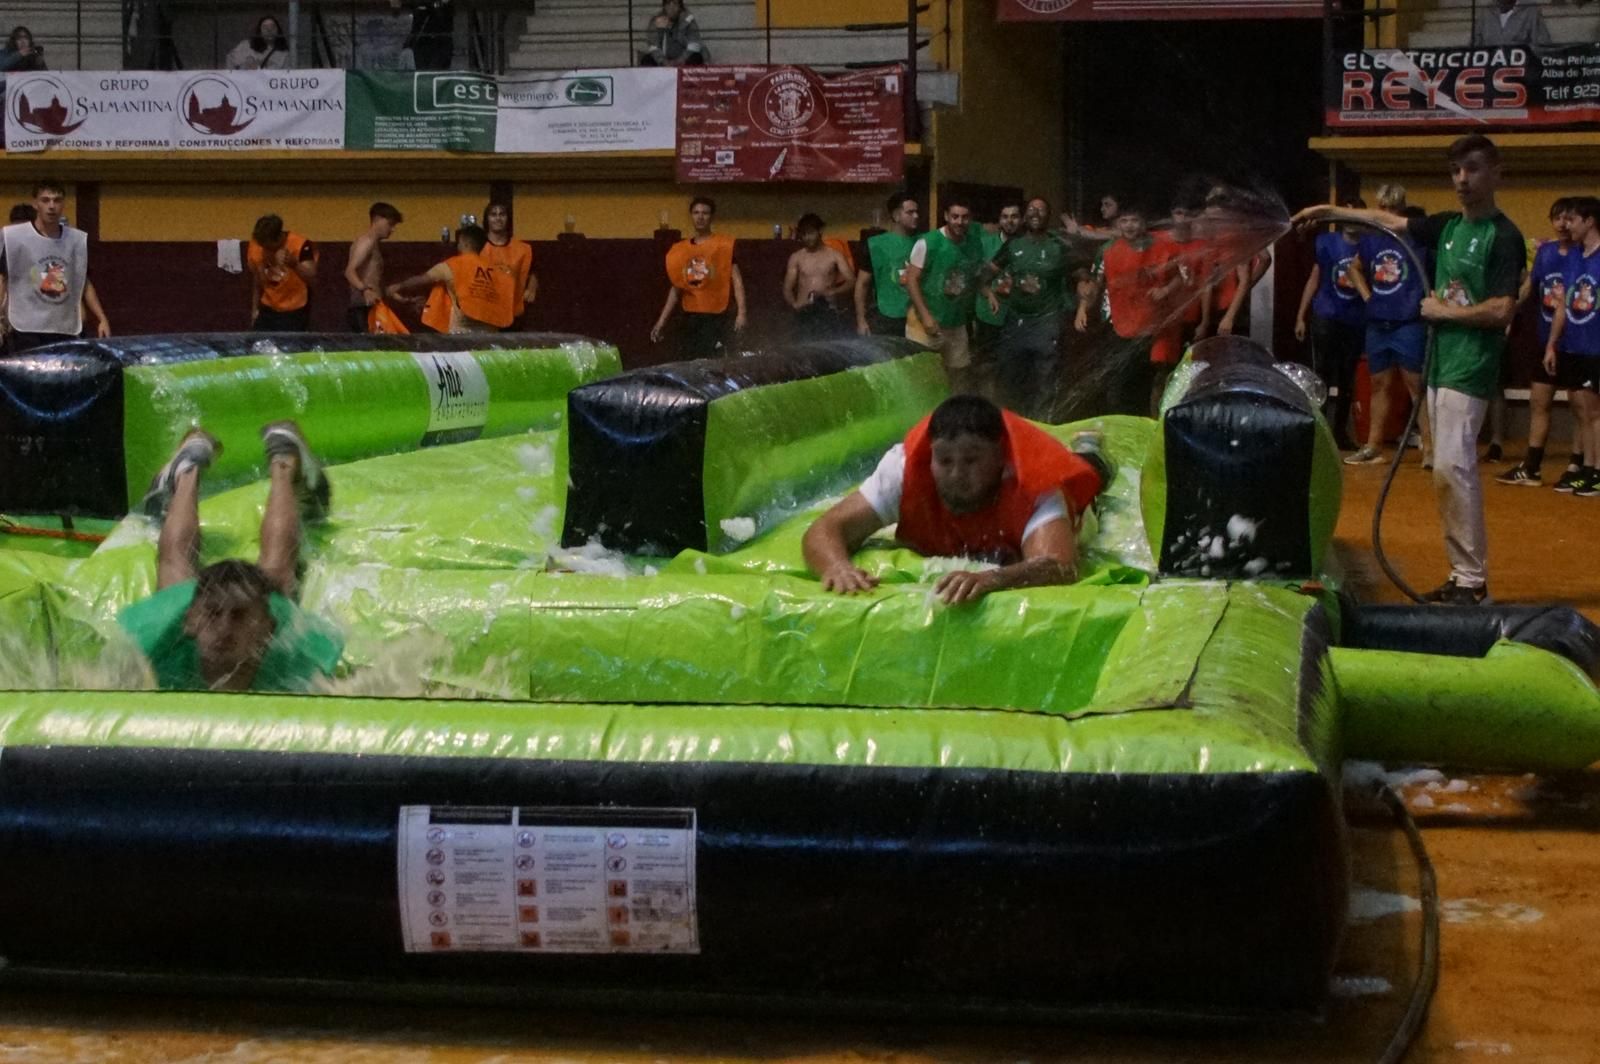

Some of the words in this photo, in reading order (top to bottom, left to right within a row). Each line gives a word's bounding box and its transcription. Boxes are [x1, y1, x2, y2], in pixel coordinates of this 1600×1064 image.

[1343, 49, 1526, 69] ELECTRICIDAD
[1541, 69, 1564, 78] Alba
[1566, 68, 1579, 78] de
[100, 79, 149, 91] GRUPO
[269, 77, 319, 90] GRUPO
[453, 81, 495, 100] est
[1341, 68, 1528, 111] REYES
[1542, 86, 1570, 100] Telf
[1573, 83, 1600, 99] 923
[76, 96, 173, 118] SALMANTINA
[245, 95, 344, 117] SALMANTINA
[105, 139, 113, 148] Y
[115, 138, 170, 148] REFORMAS
[179, 138, 272, 148] CONSTRUCCIONES
[275, 138, 283, 147] Y
[285, 137, 341, 147] REFORMAS
